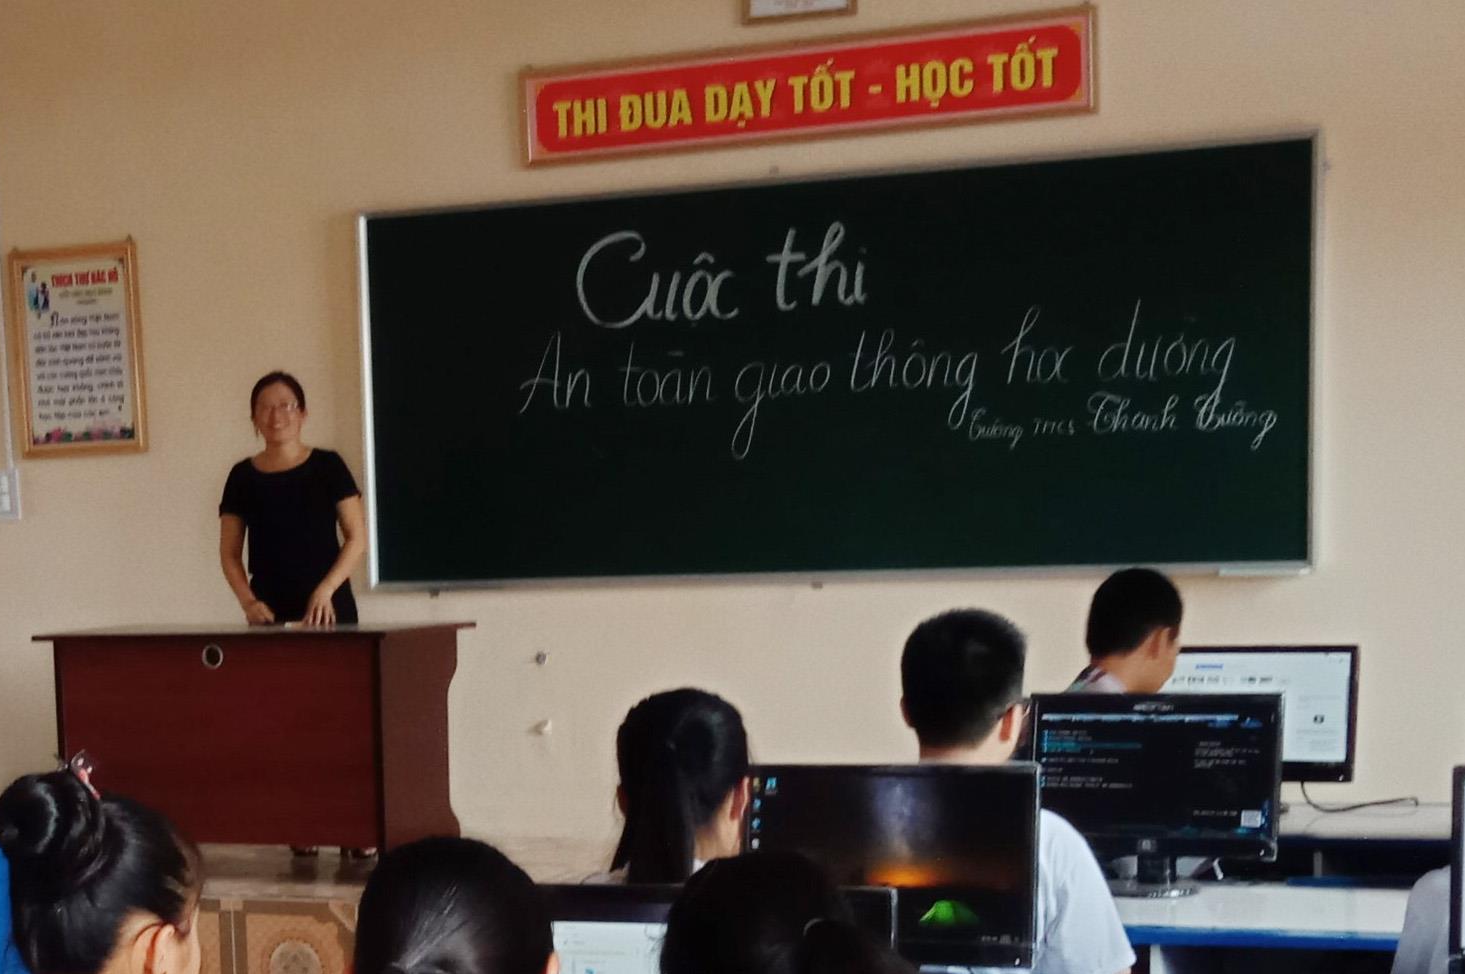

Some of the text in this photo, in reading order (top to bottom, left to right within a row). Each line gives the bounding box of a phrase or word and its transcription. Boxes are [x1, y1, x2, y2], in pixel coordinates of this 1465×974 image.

[552, 97, 608, 139] THI
[619, 88, 693, 132] ĐUA
[704, 78, 777, 128] DẠY
[788, 57, 855, 114] TỐT
[896, 57, 973, 107] HỌC
[987, 35, 1058, 94] TỐT
[766, 221, 868, 312] thi
[520, 331, 591, 414] An
[732, 360, 830, 459] giao
[849, 328, 978, 422] thông
[1087, 390, 1180, 434] Thanh
